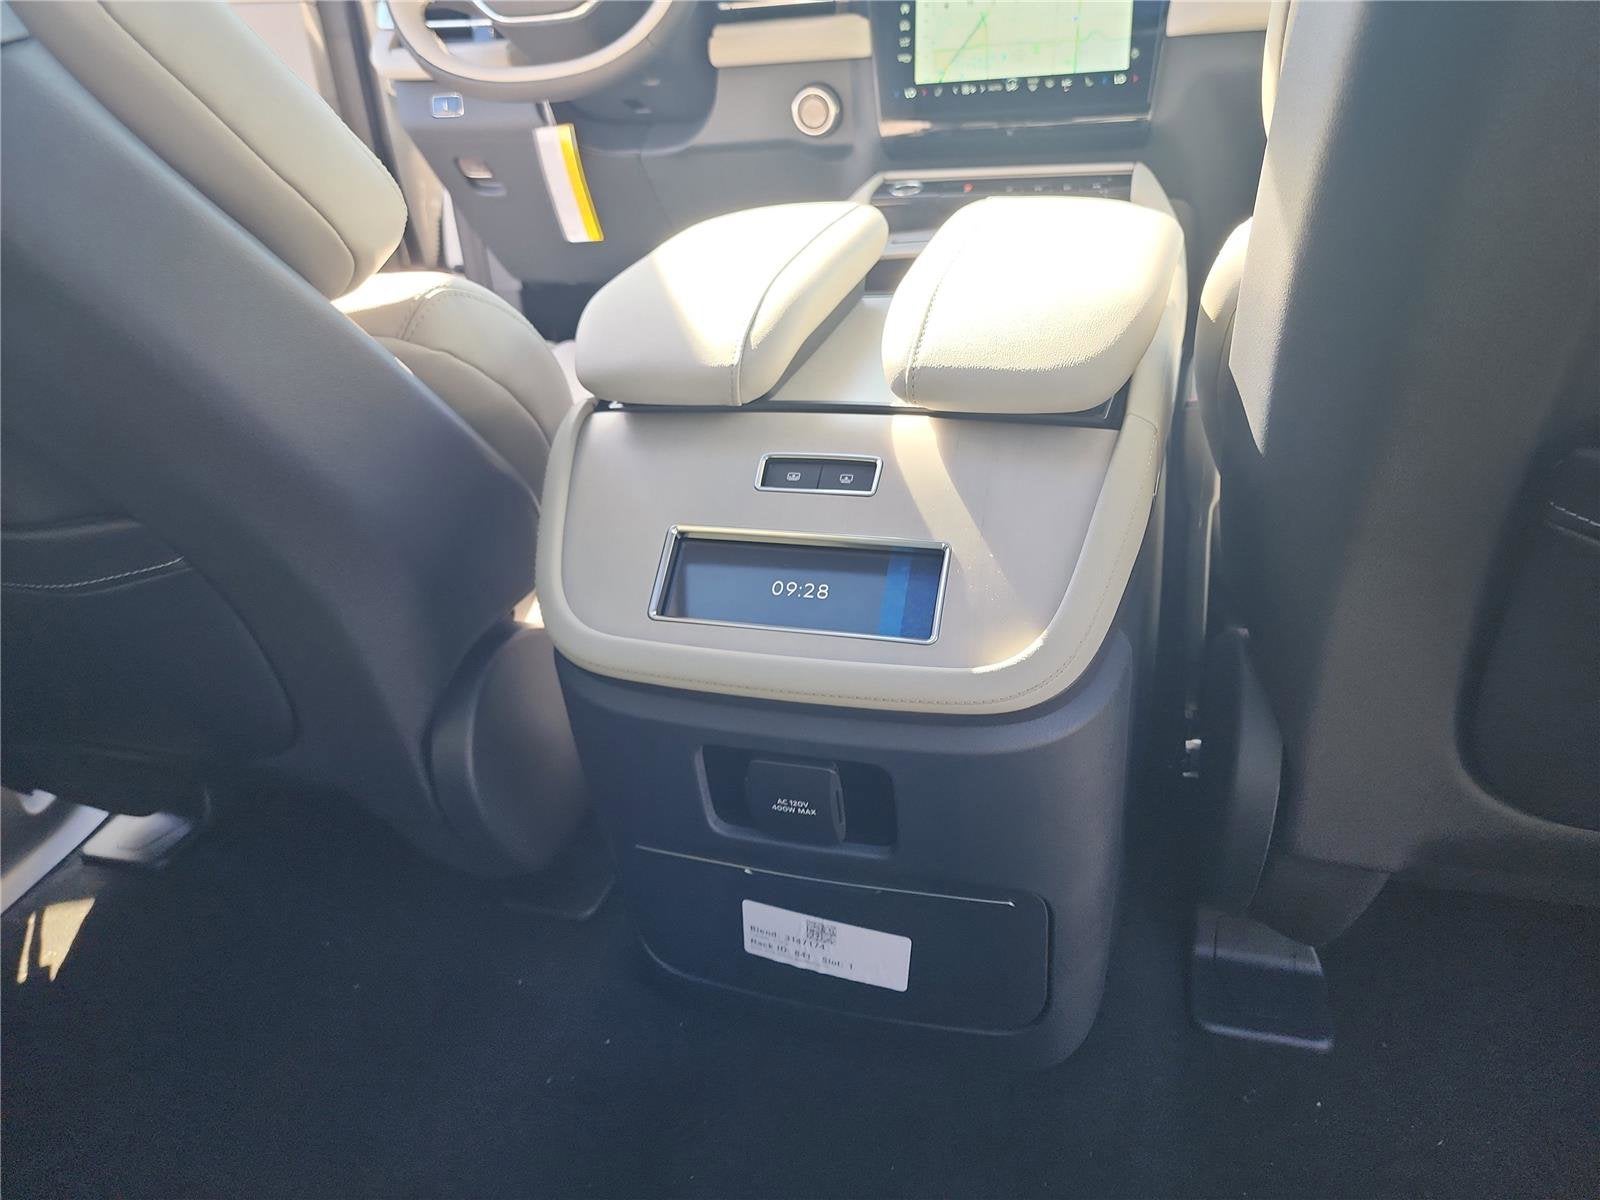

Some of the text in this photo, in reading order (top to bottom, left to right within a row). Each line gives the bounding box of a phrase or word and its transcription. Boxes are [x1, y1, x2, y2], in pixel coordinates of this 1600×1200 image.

[771, 580, 829, 600] 09:28
[777, 798, 809, 808] AC 120V
[772, 804, 816, 816] 400W MAX
